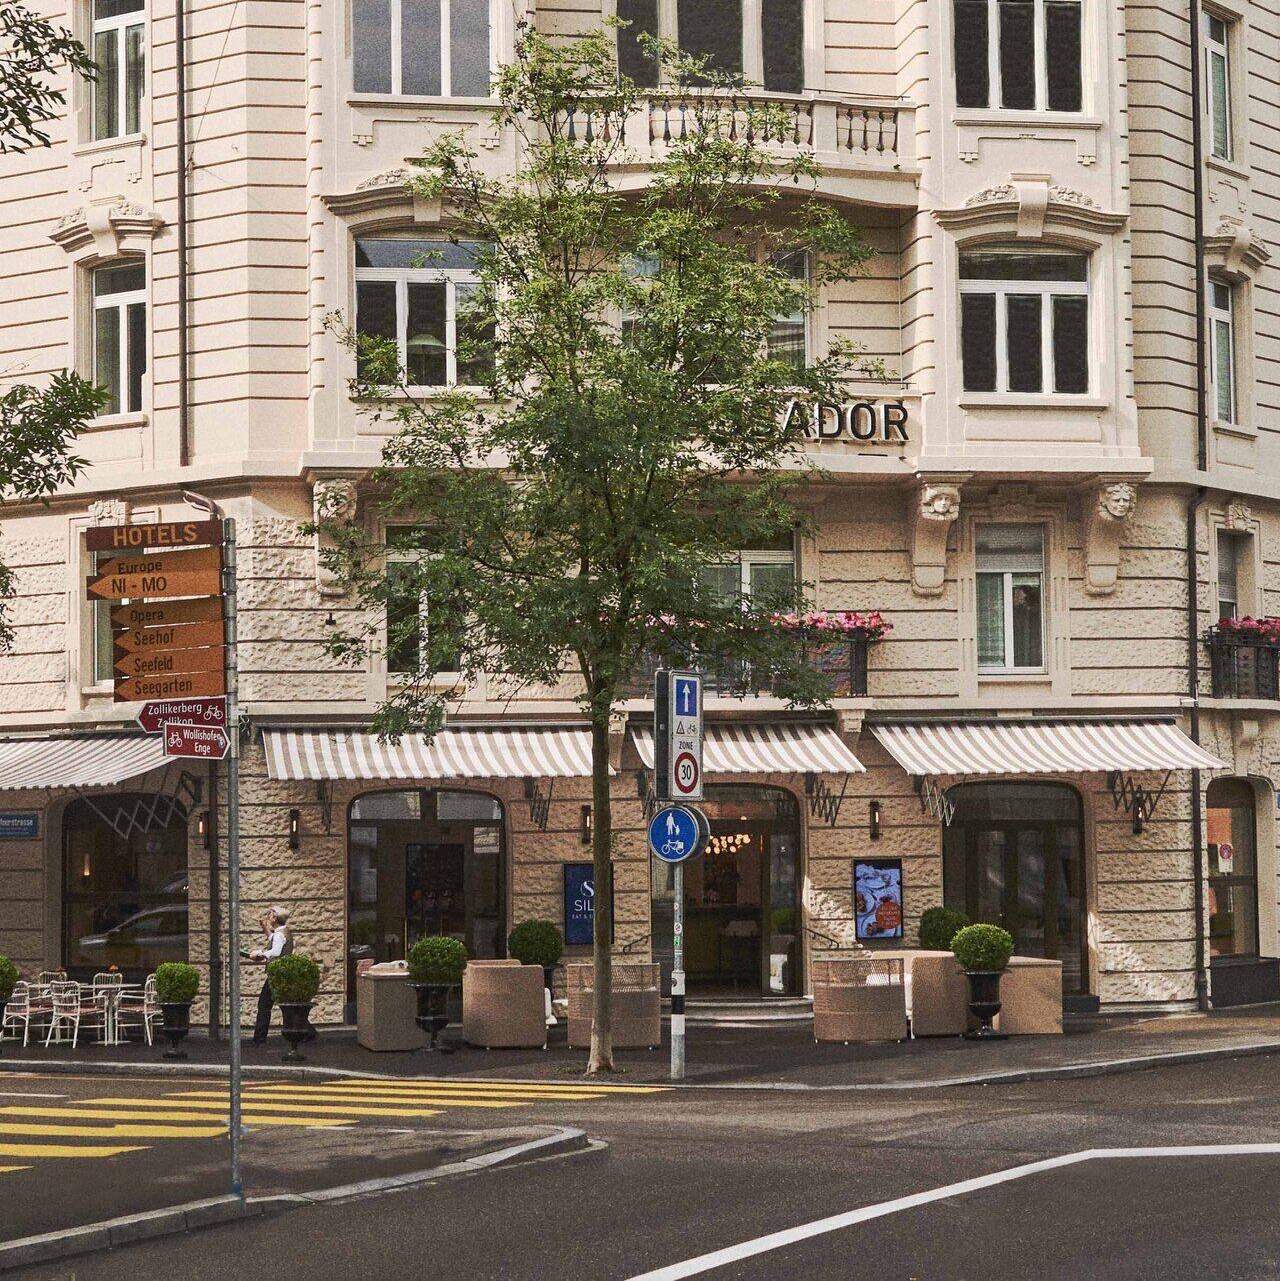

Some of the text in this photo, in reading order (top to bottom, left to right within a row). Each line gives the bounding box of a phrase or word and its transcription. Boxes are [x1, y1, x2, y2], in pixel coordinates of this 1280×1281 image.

[783, 401, 910, 441] ADOR
[113, 523, 198, 547] HOTELS
[117, 561, 163, 575] Europe
[111, 578, 126, 593] NI
[142, 577, 167, 593] MO
[130, 610, 164, 625] Opera
[134, 629, 175, 646] Seehof
[134, 655, 173, 673] Seefeld
[134, 679, 193, 696] Seegarten
[148, 703, 202, 715] Zollikerberg
[194, 742, 211, 754] Enge
[678, 741, 694, 750] ZONE
[681, 764, 692, 780] 30
[574, 899, 595, 912] SIL
